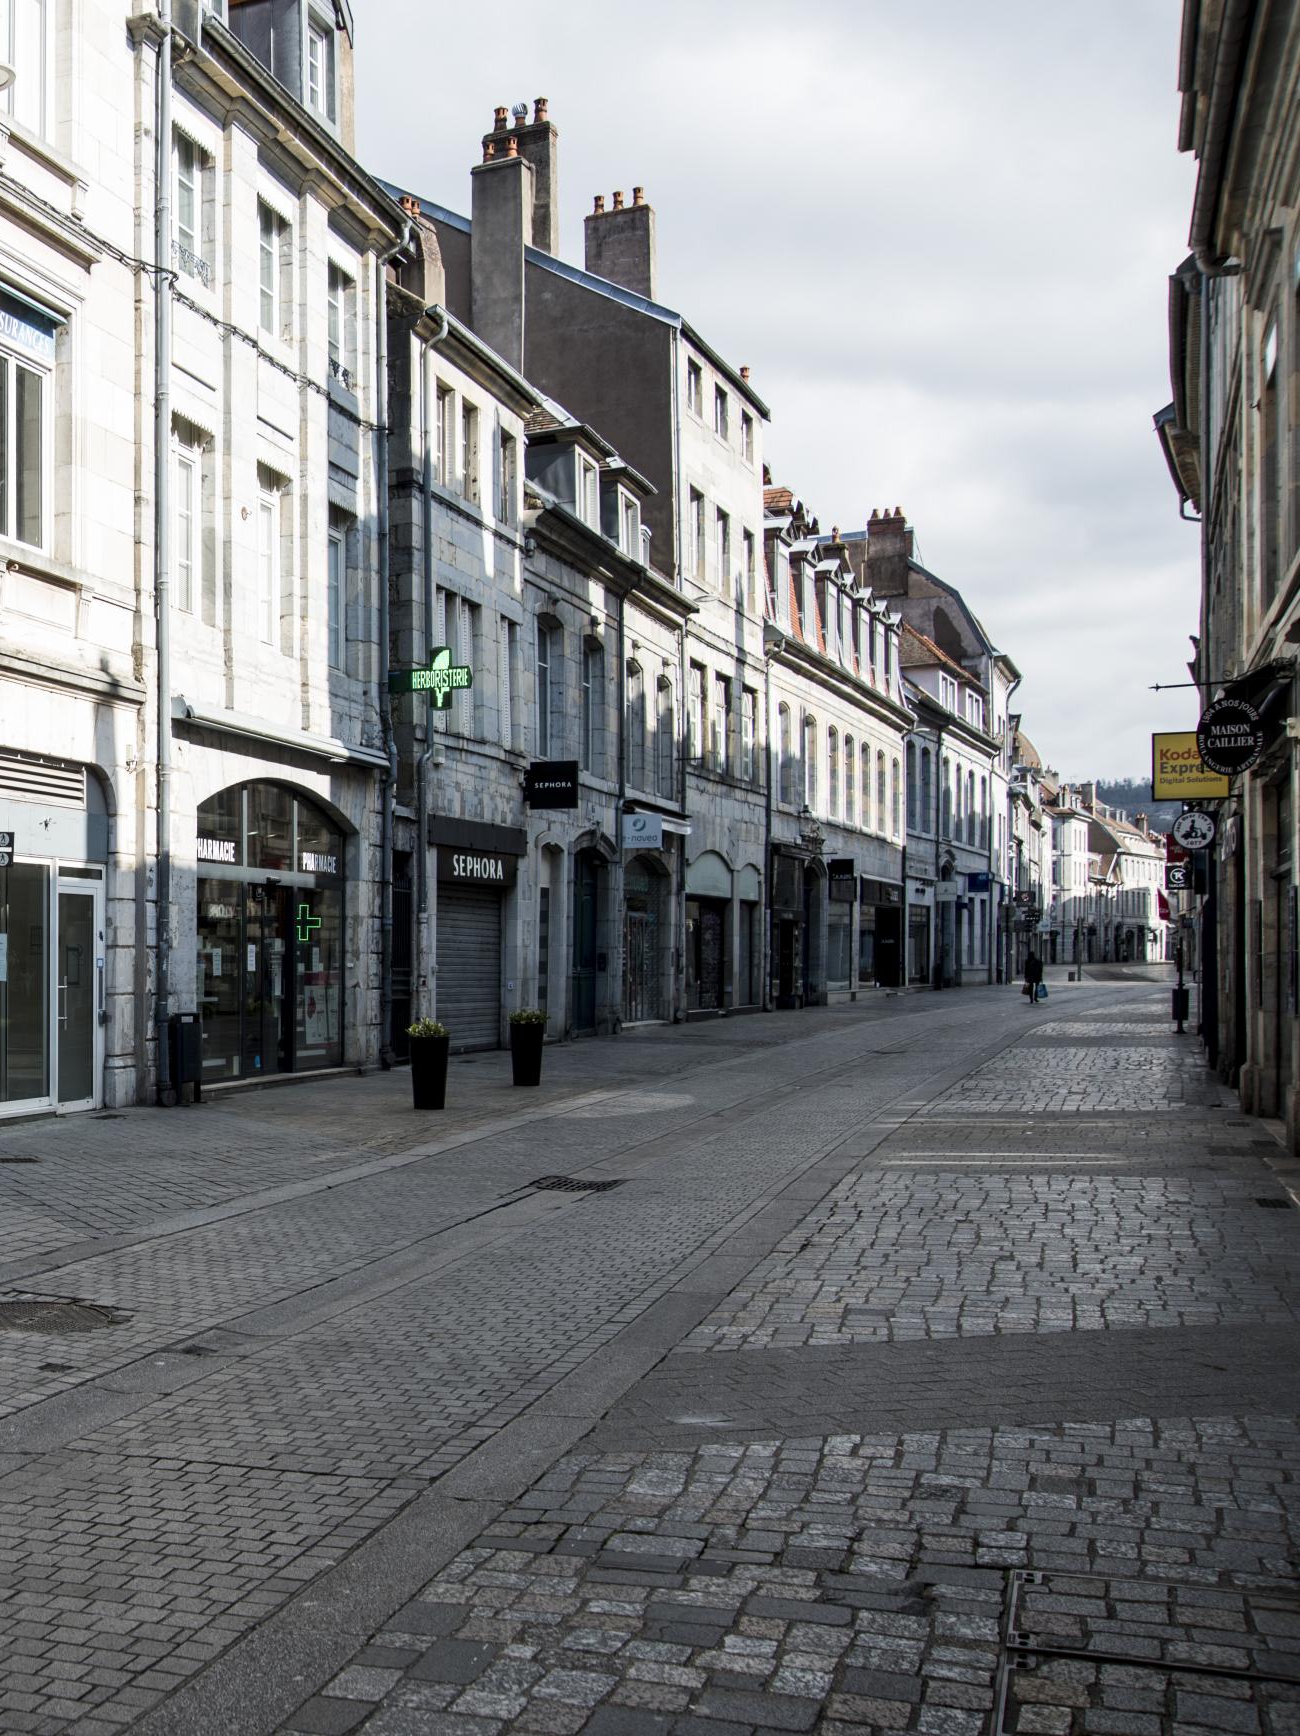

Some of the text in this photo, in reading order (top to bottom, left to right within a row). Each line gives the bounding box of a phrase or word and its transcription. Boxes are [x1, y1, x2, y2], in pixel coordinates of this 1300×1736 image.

[412, 668, 468, 689] HERBORISTERIE
[1221, 699, 1241, 708] NOS
[1238, 702, 1260, 721] JOURS
[1211, 723, 1251, 736] MAISON
[1198, 730, 1264, 774] BOULANGERIE ARTISANALE
[1207, 736, 1256, 748] CAILLIER
[1160, 747, 1200, 761] Koda
[1160, 775, 1223, 785] Digital Solutions
[196, 837, 236, 863] HARMACIE
[302, 851, 337, 873] PHARMACIE
[453, 854, 504, 880] SEPHORA
